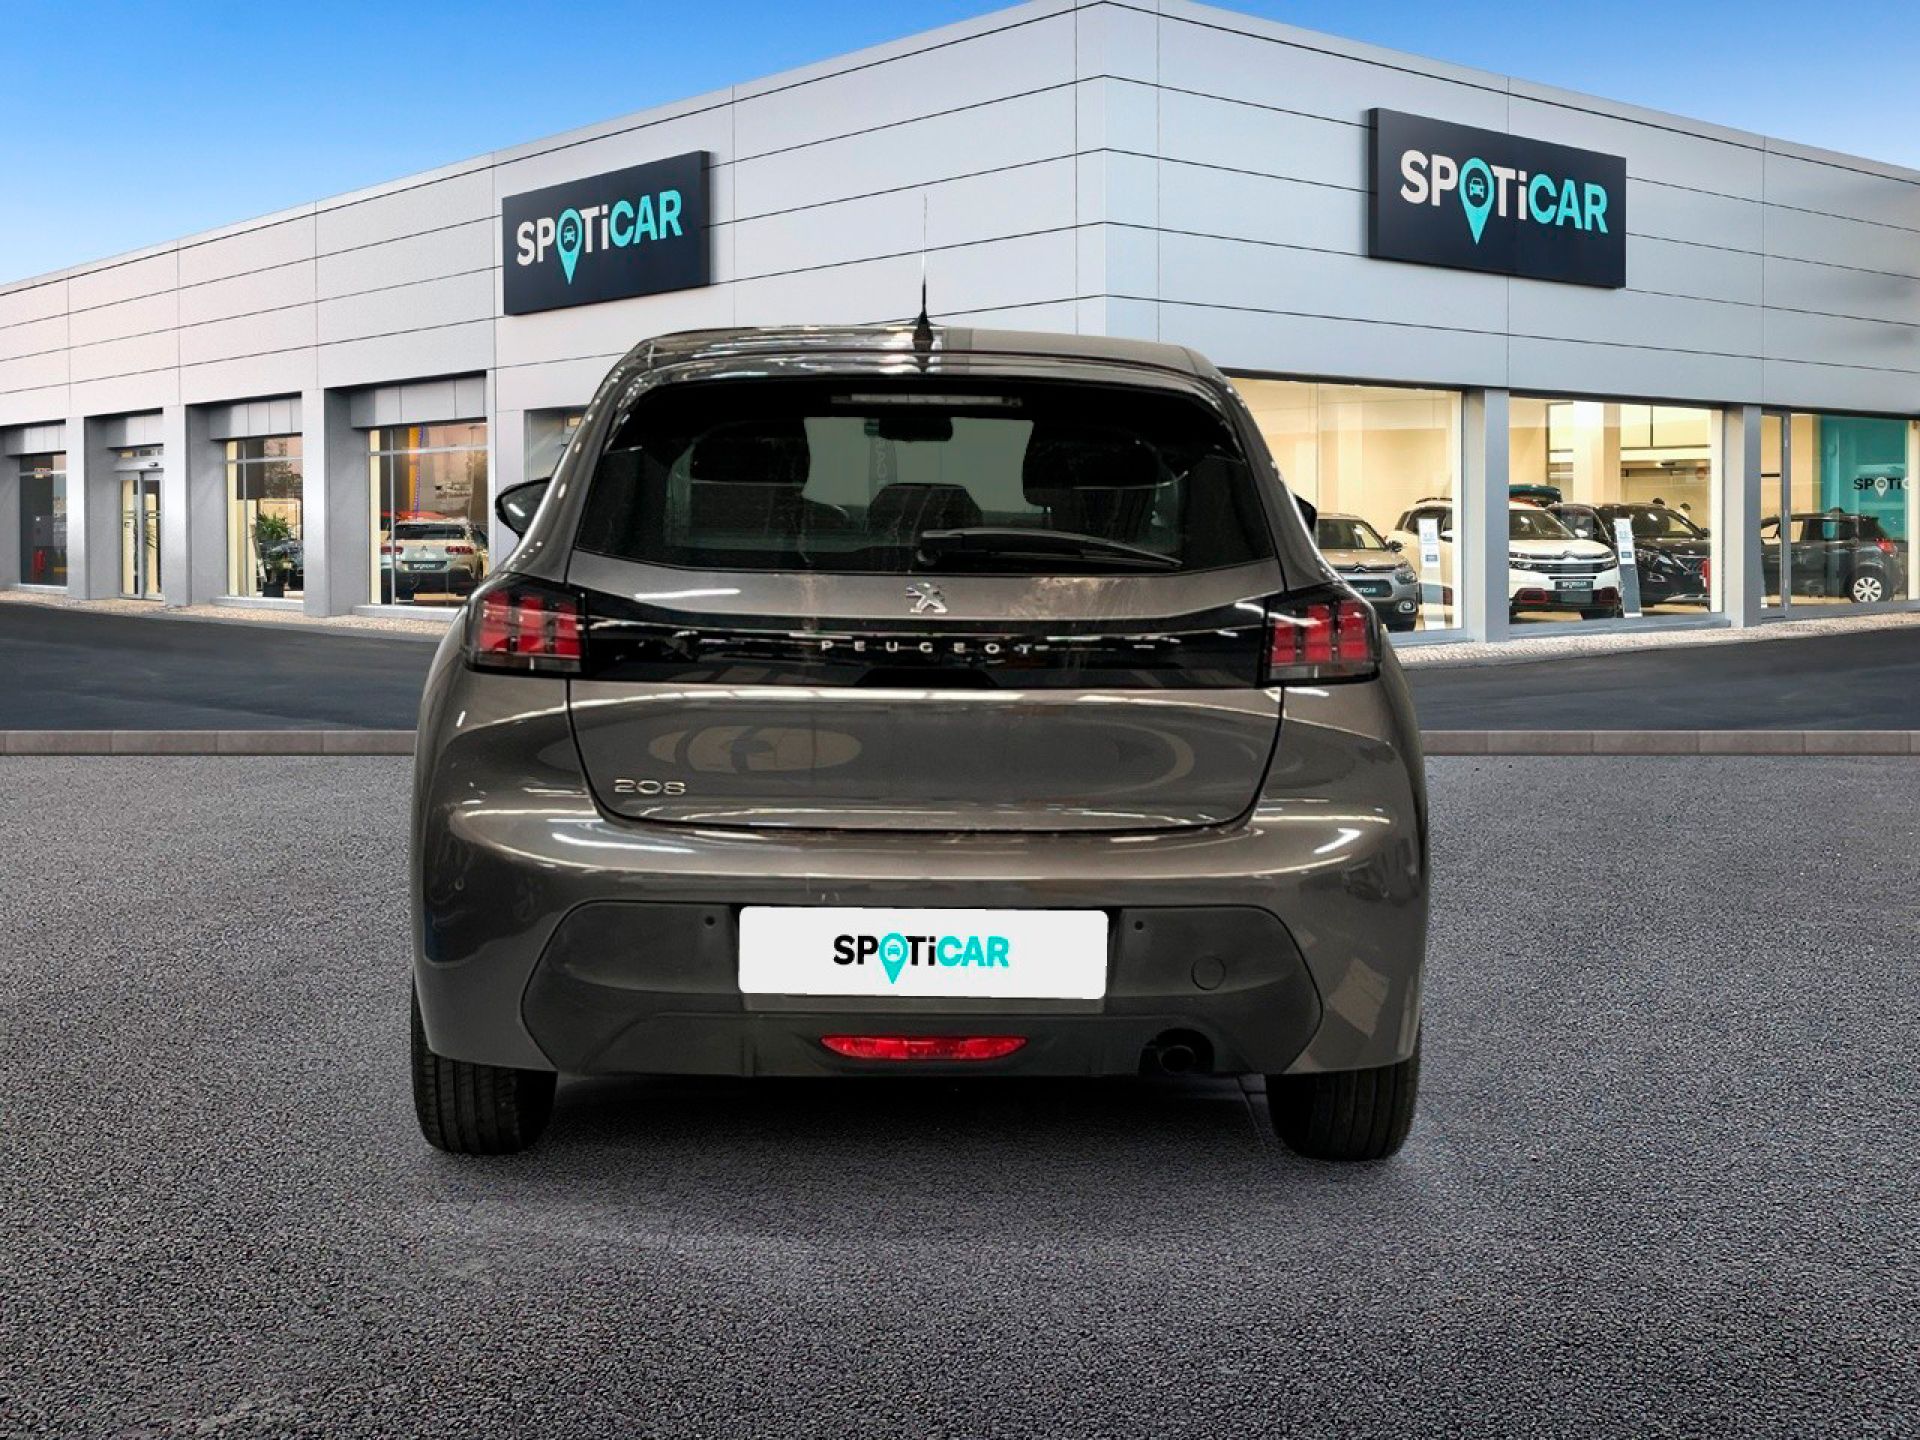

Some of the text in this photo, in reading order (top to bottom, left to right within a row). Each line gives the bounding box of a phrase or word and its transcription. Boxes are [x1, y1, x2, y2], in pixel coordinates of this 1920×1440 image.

[1401, 149, 1609, 245] SPOTiCAR
[516, 189, 683, 285] SPOTiCAR
[821, 640, 1032, 655] PEUGEOT
[614, 779, 687, 796] 208
[833, 932, 1009, 984] SPOTiCAR
